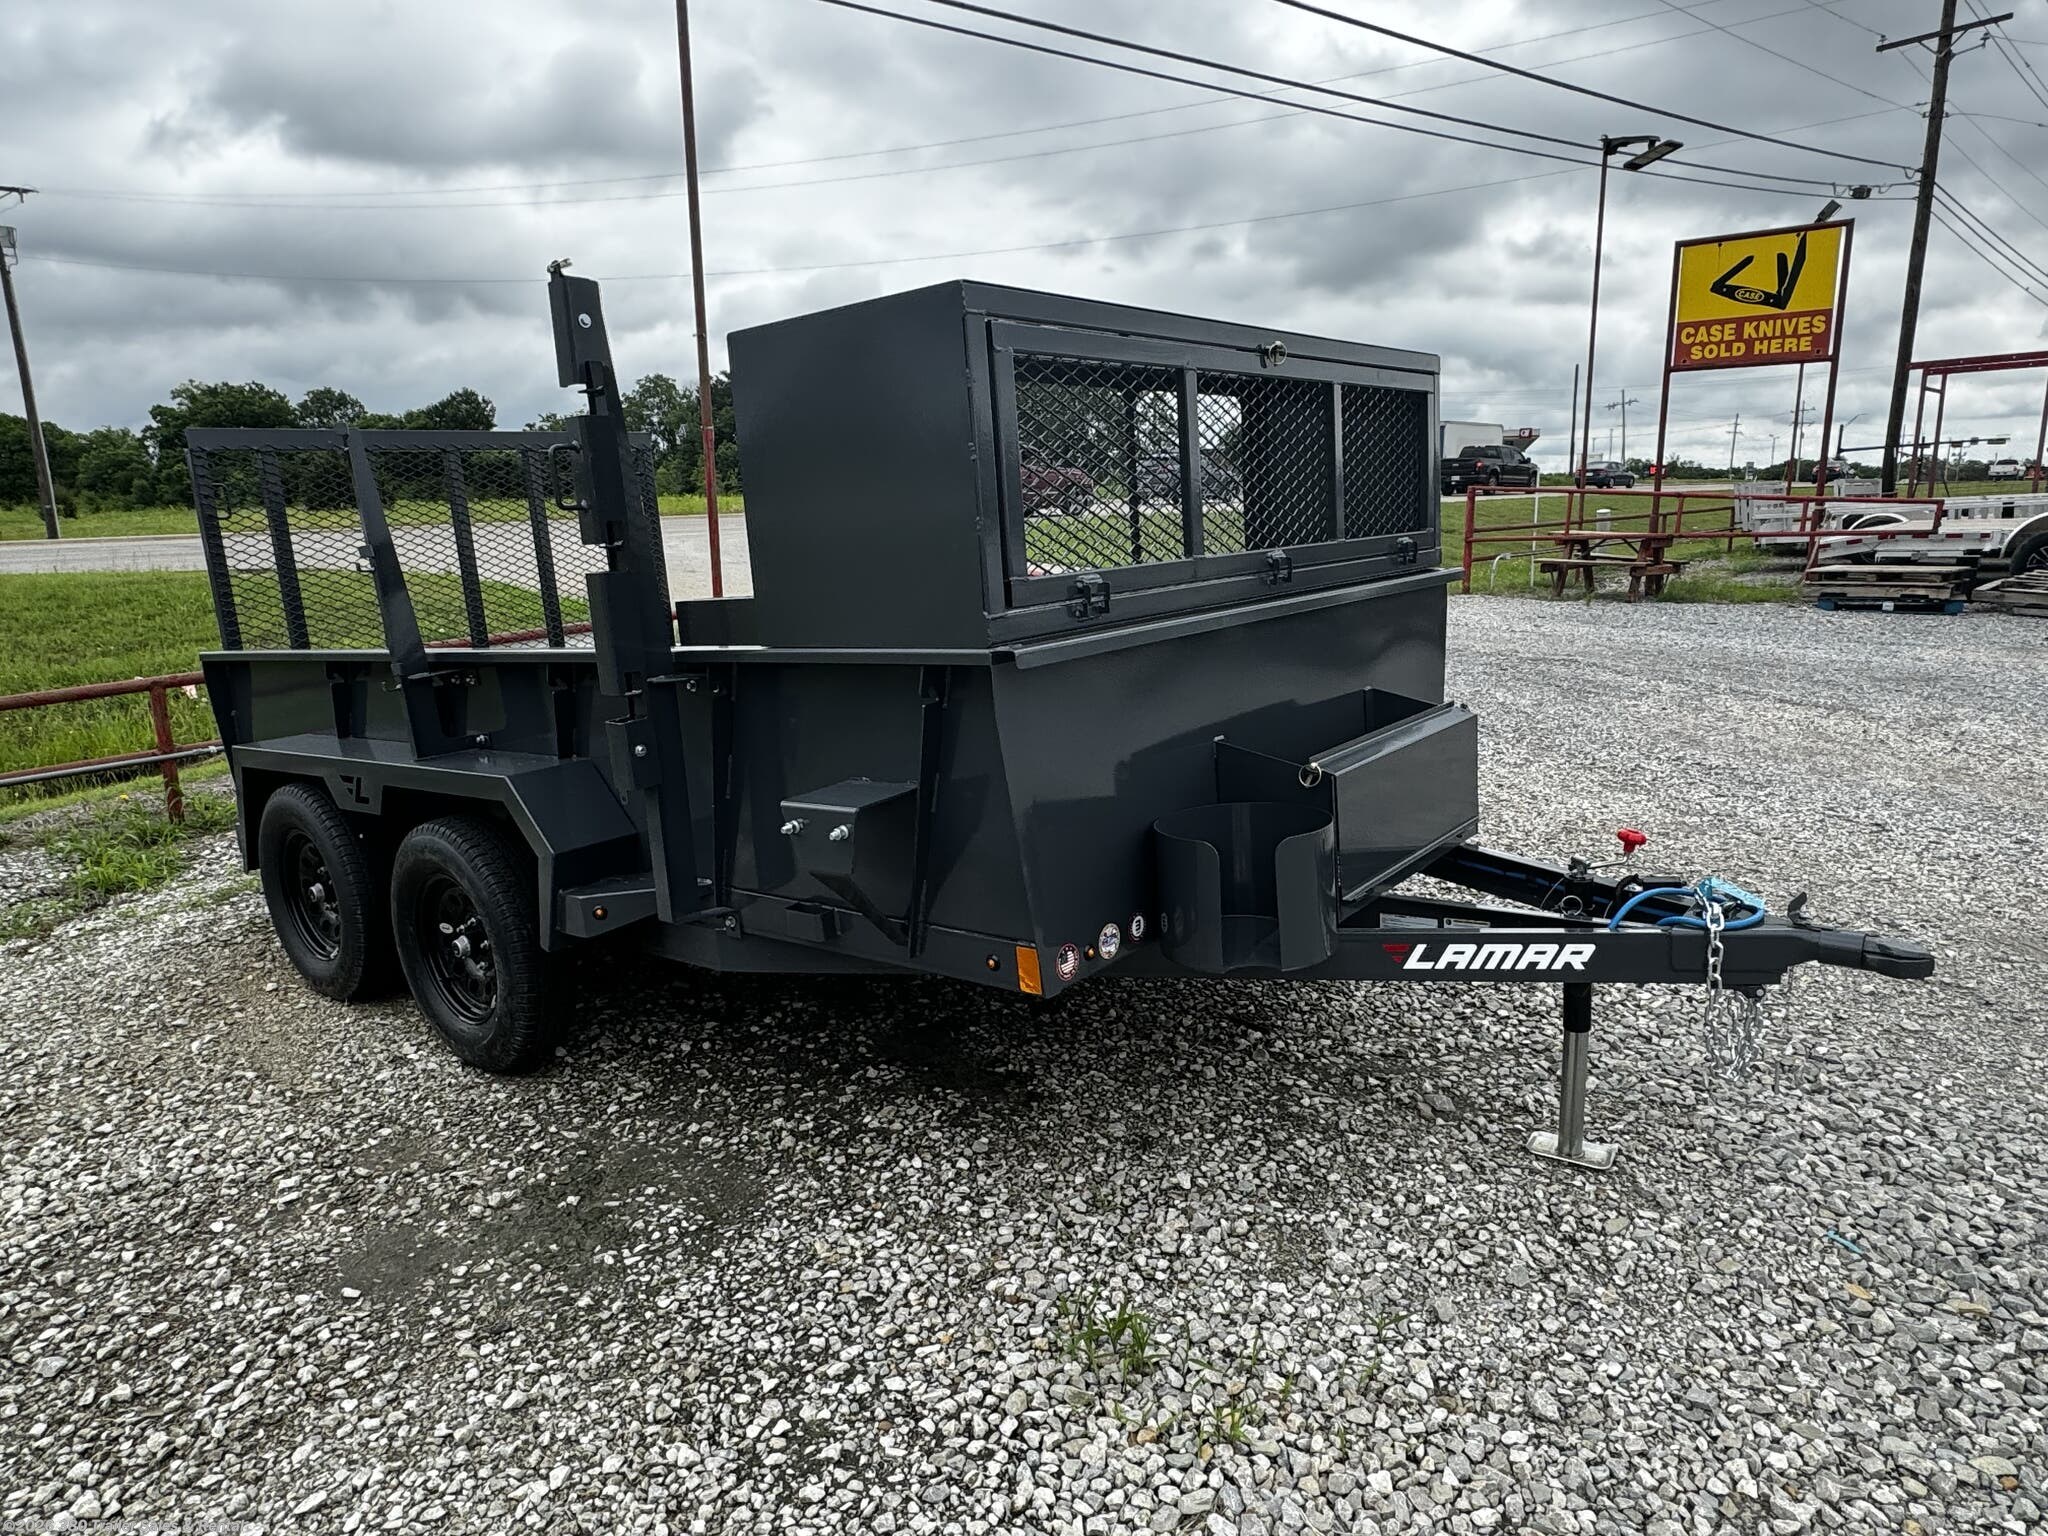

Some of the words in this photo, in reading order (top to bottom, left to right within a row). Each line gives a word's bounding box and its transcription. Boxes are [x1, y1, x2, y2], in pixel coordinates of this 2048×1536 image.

[1738, 290, 1760, 300] CASE
[1680, 323, 1736, 345] CASE
[1743, 315, 1826, 339] KNIVES
[1690, 342, 1746, 360] SOLD
[1753, 336, 1813, 355] HERE
[1402, 944, 1597, 970] LAMAR
